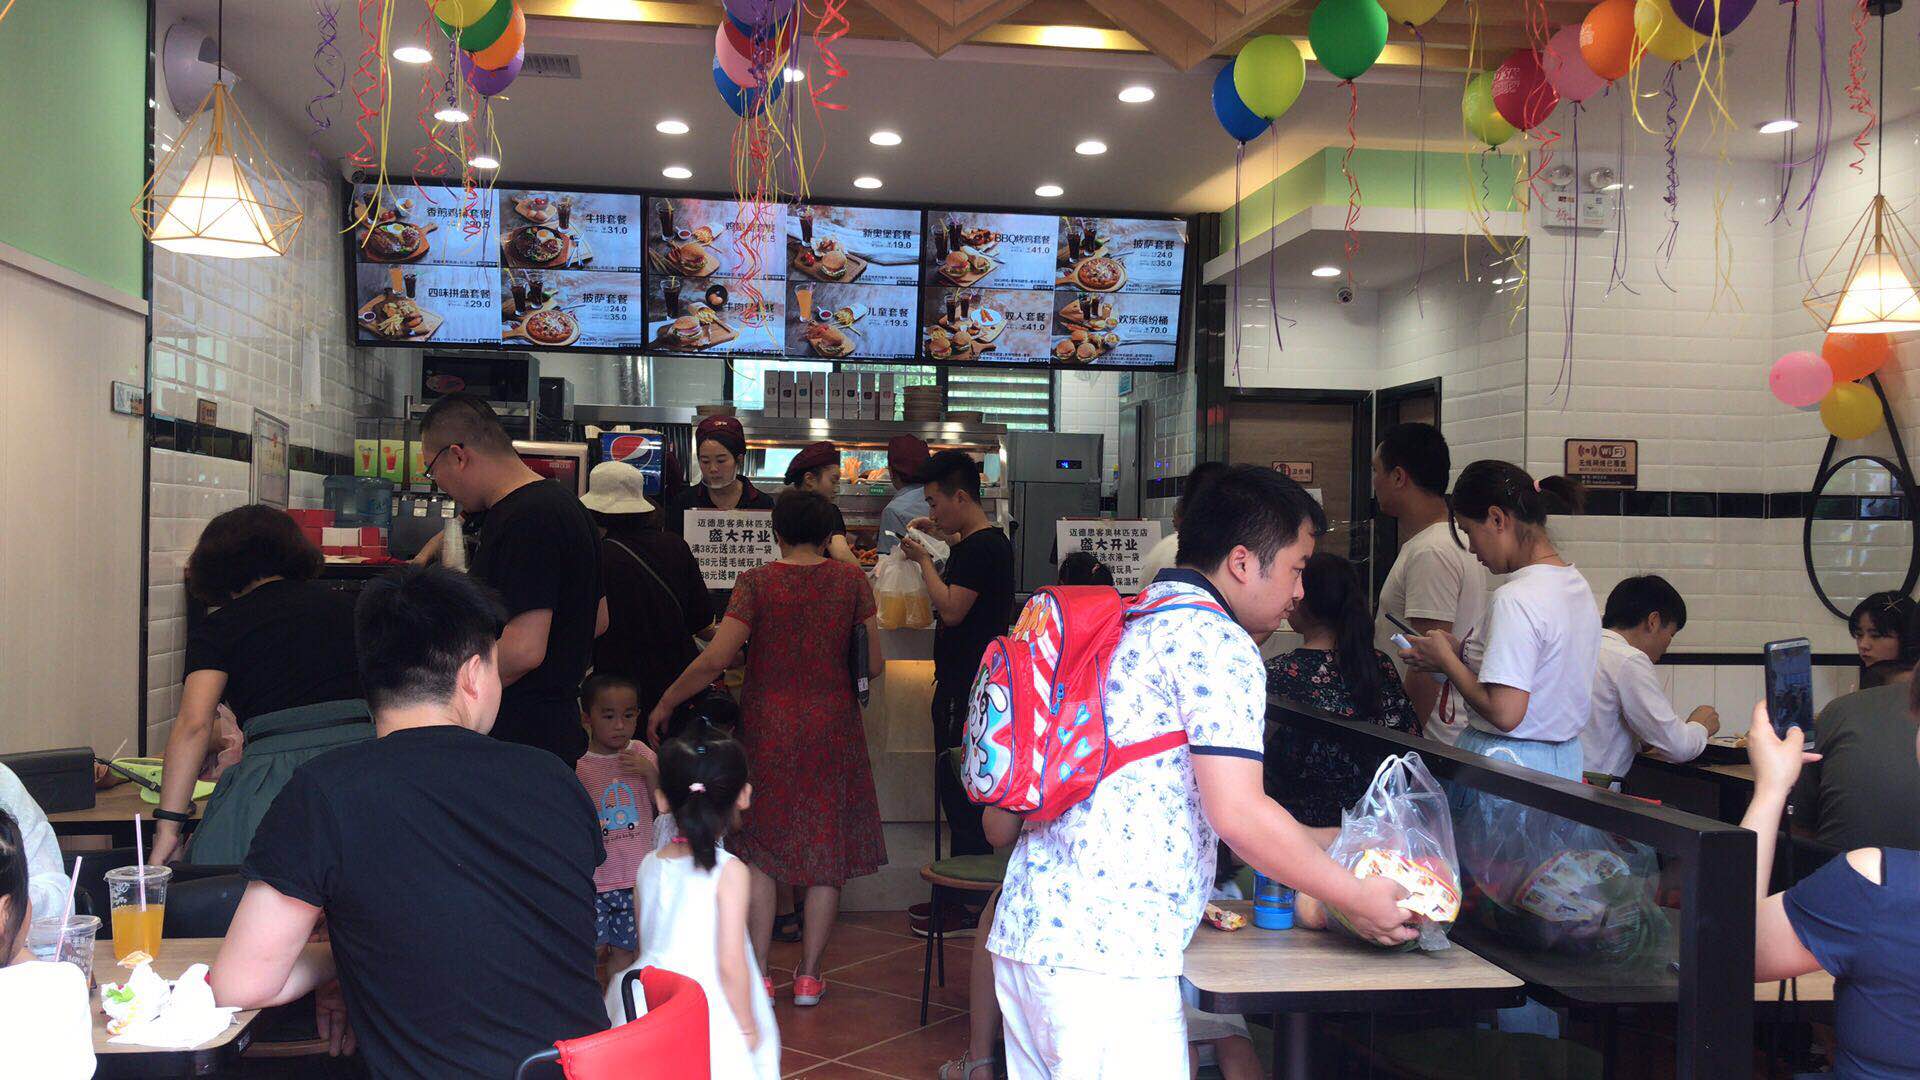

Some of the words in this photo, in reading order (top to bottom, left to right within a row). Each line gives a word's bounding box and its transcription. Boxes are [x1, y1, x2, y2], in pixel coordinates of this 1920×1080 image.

[586, 213, 627, 224] 牛排套餐
[608, 226, 628, 234] 31.0
[893, 241, 912, 249] 19.0
[1031, 246, 1050, 254] 41.0
[428, 288, 490, 299] 四味拼盘套餐
[470, 300, 491, 308] 29.0
[610, 305, 627, 313] 24.0
[867, 306, 909, 317] 儿童套餐
[610, 313, 627, 321] 35.0
[1005, 311, 1046, 321] 双人套餐
[1118, 314, 1169, 325] 欢乐缤纷桶
[890, 319, 909, 327] 19.5
[1027, 323, 1045, 331] 41.0
[1150, 326, 1168, 334] 70.0
[709, 529, 770, 542] 盛大开业
[1080, 537, 1138, 551] 盛大开业
